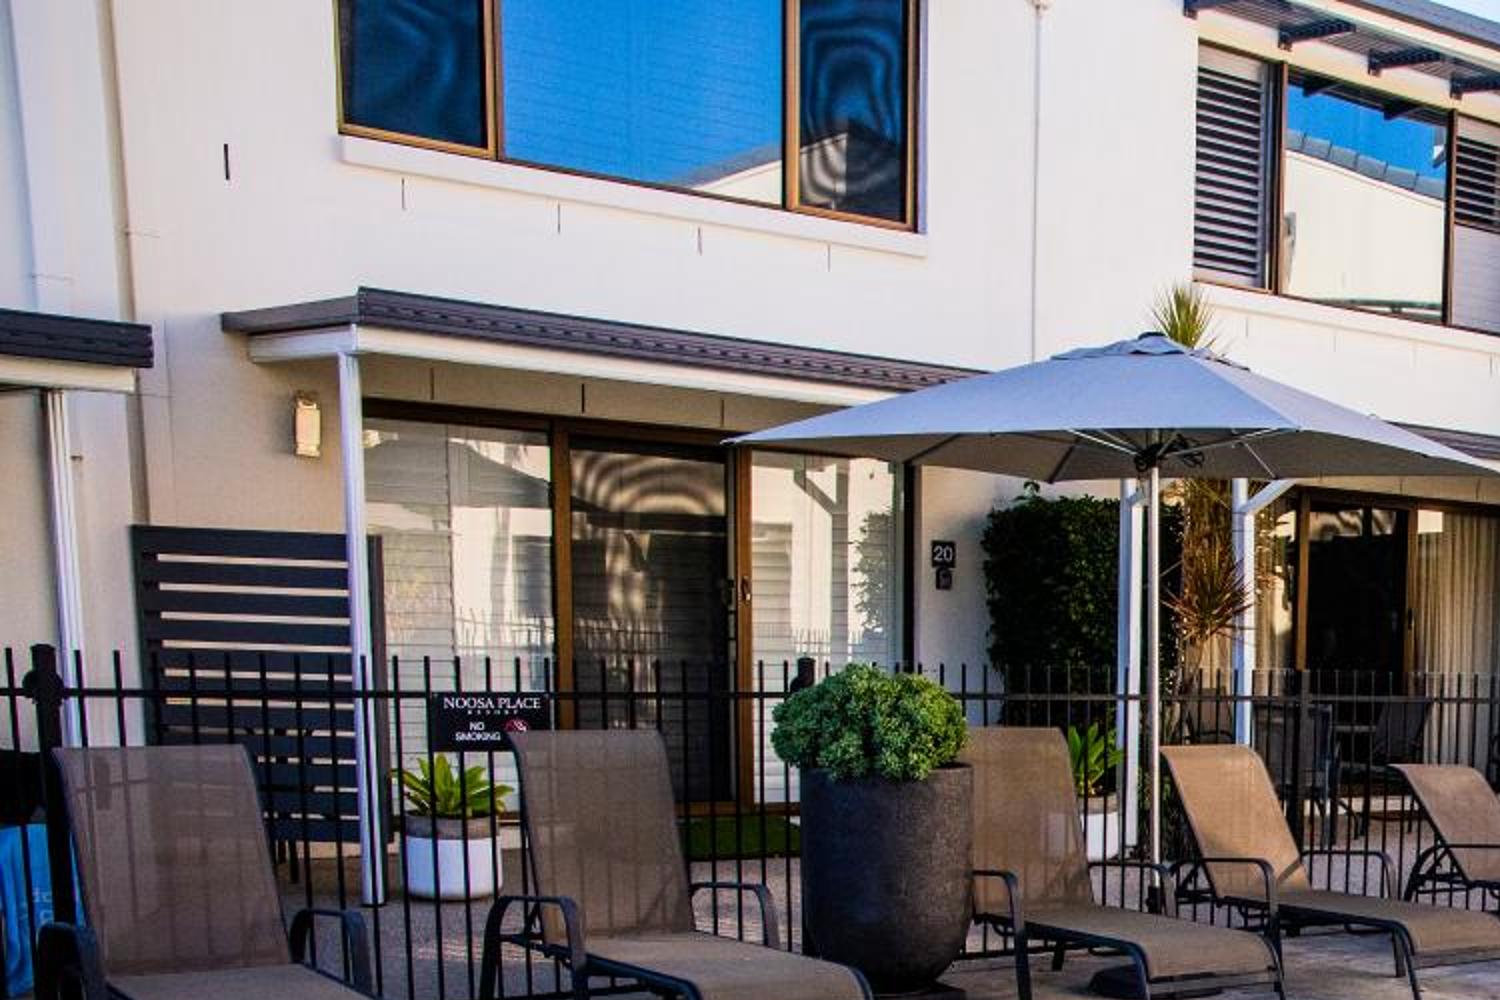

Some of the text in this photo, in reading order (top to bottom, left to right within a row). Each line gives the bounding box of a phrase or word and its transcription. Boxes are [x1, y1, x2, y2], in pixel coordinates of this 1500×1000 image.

[933, 545, 953, 561] 20
[443, 697, 541, 710] NOOSA PLACE
[469, 722, 485, 731] NO
[455, 732, 501, 741] SMOKING
